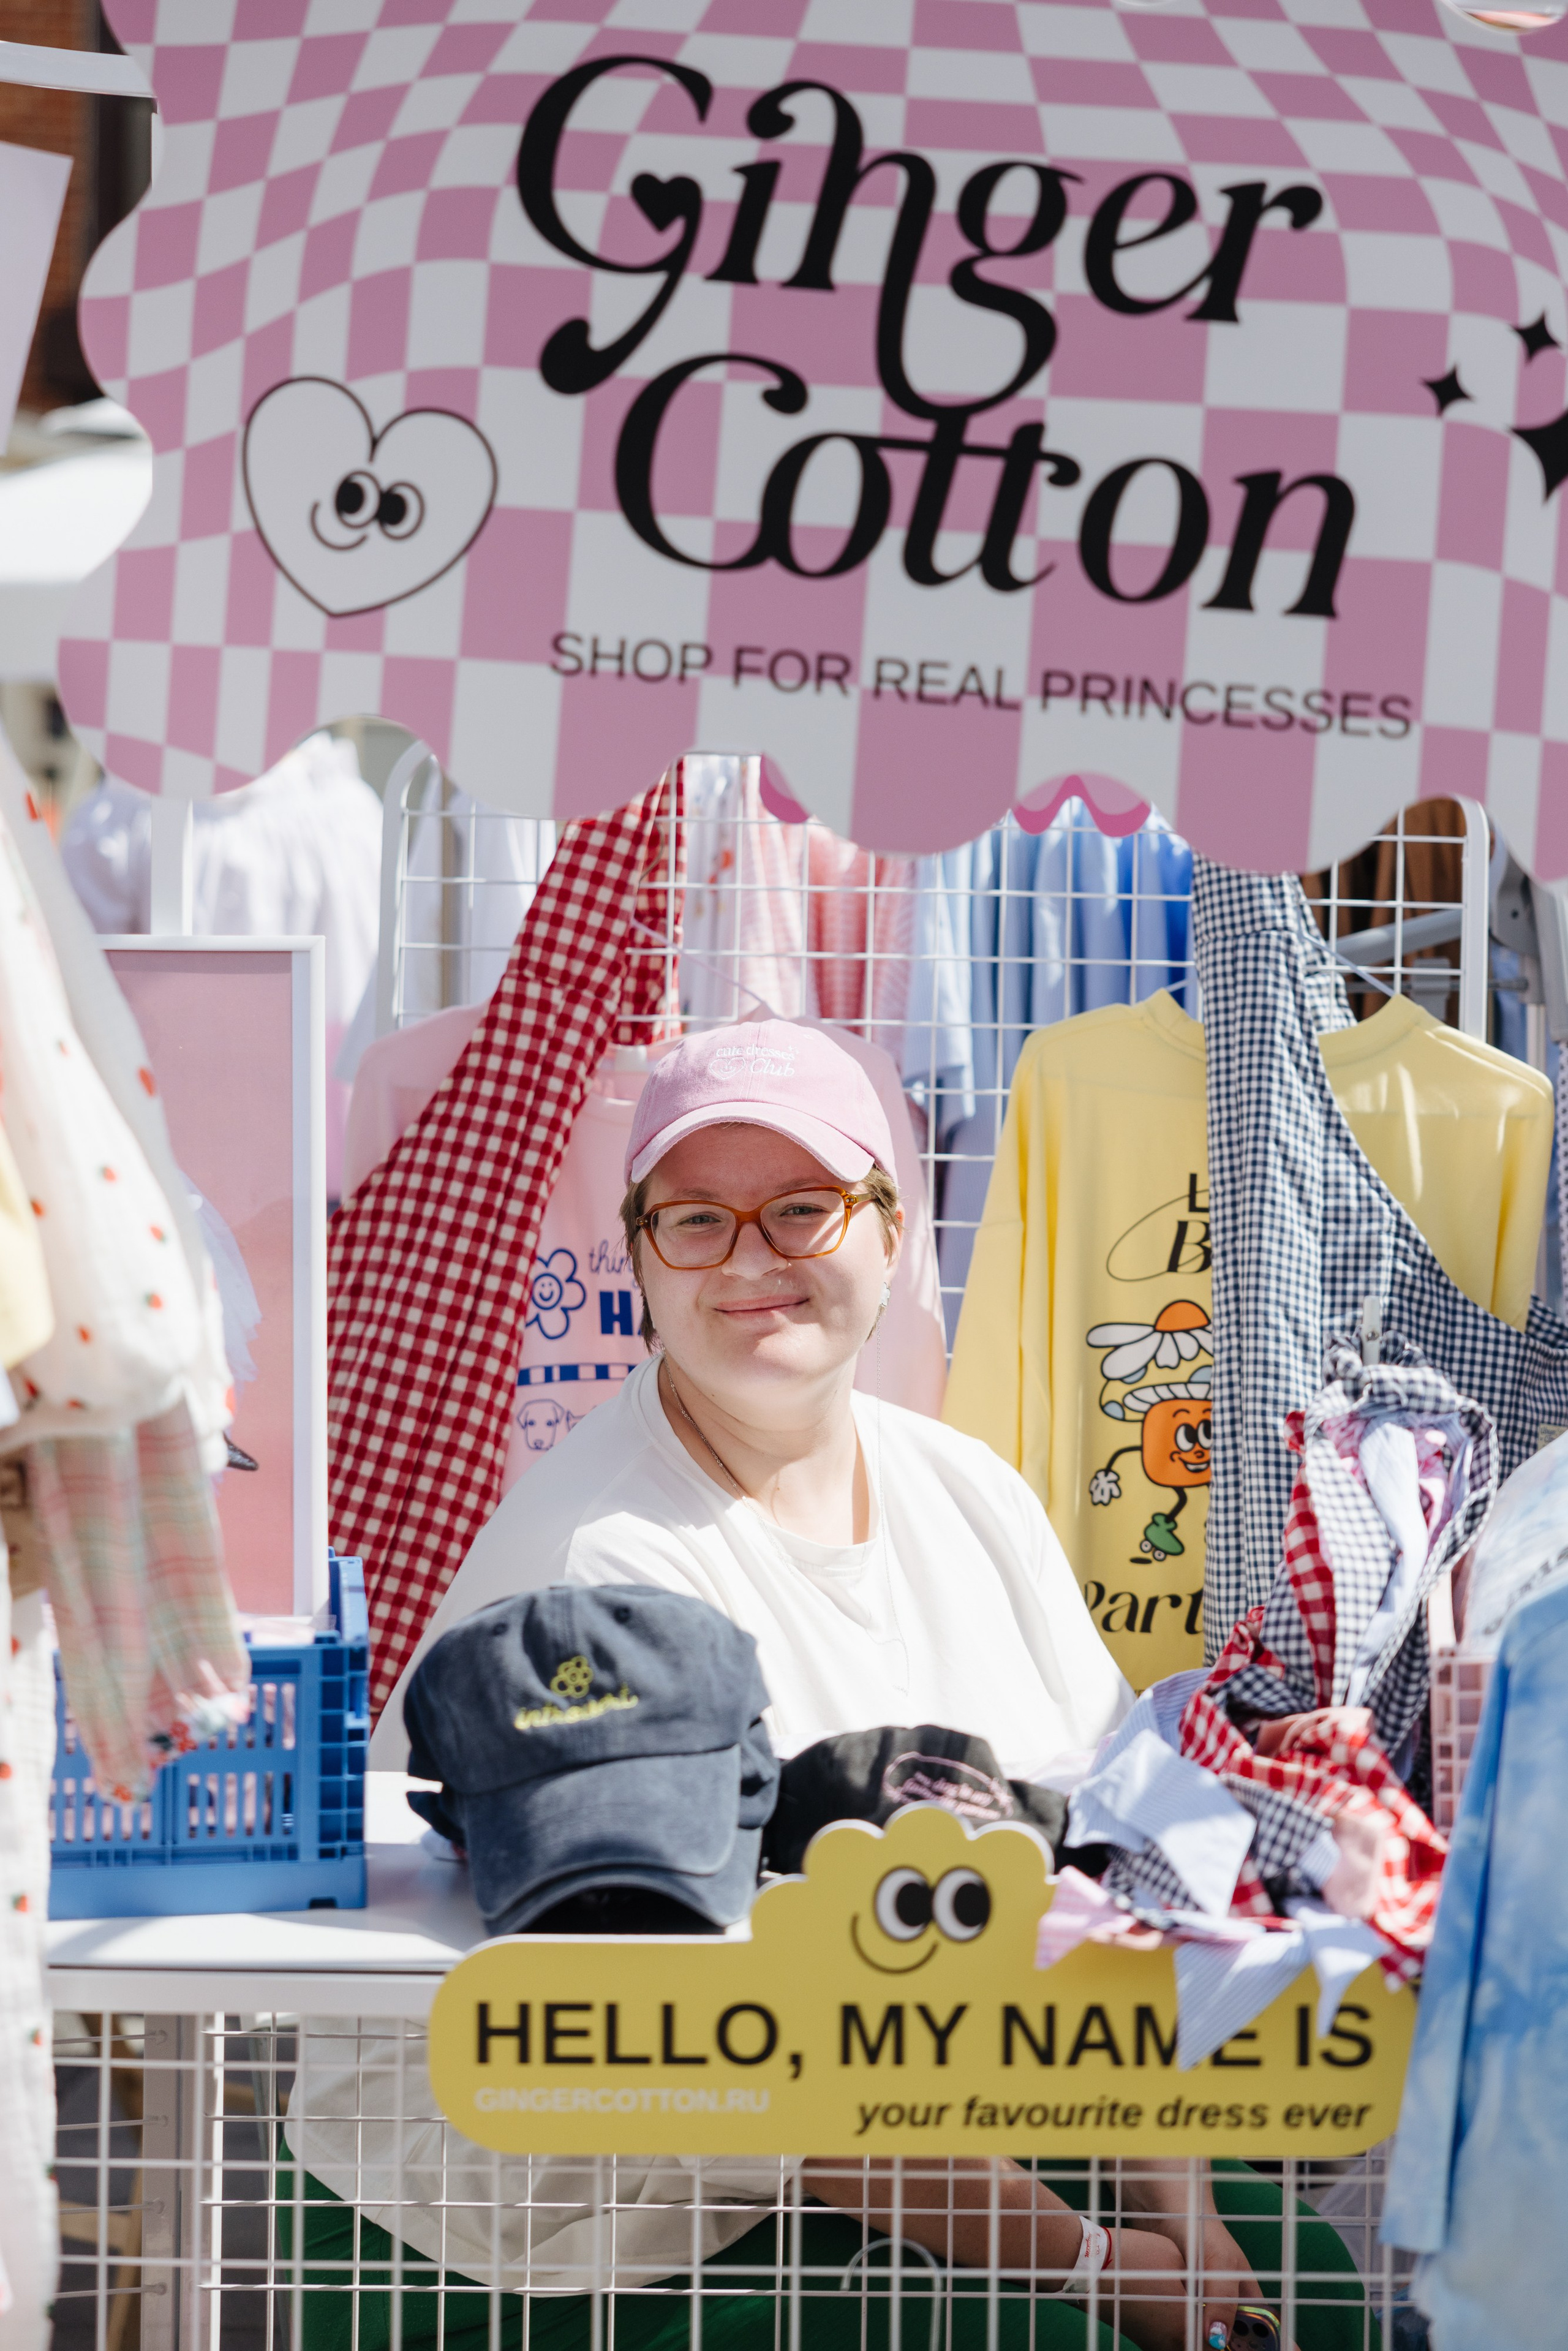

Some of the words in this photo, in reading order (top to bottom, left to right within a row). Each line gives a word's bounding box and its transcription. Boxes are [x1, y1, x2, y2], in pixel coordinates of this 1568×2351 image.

[515, 55, 1324, 421] Ginger
[614, 353, 1356, 619] Cotton
[547, 631, 715, 685] SHOP
[731, 644, 853, 697] FOR
[871, 657, 1022, 711] REAL
[1039, 668, 1414, 740] PRINCESSES
[716, 1046, 743, 1057] cute
[746, 1043, 795, 1060] dresses
[749, 1057, 795, 1077] Club
[475, 2001, 804, 2080] HELLO,
[839, 2002, 970, 2067] MY
[1295, 2002, 1374, 2069] IS
[473, 2087, 771, 2115] GINGERCOTTON.RU
[854, 2102, 951, 2137] your
[963, 2095, 1144, 2130] favourite
[1155, 2095, 1268, 2130] dress
[1282, 2102, 1373, 2130] ever
